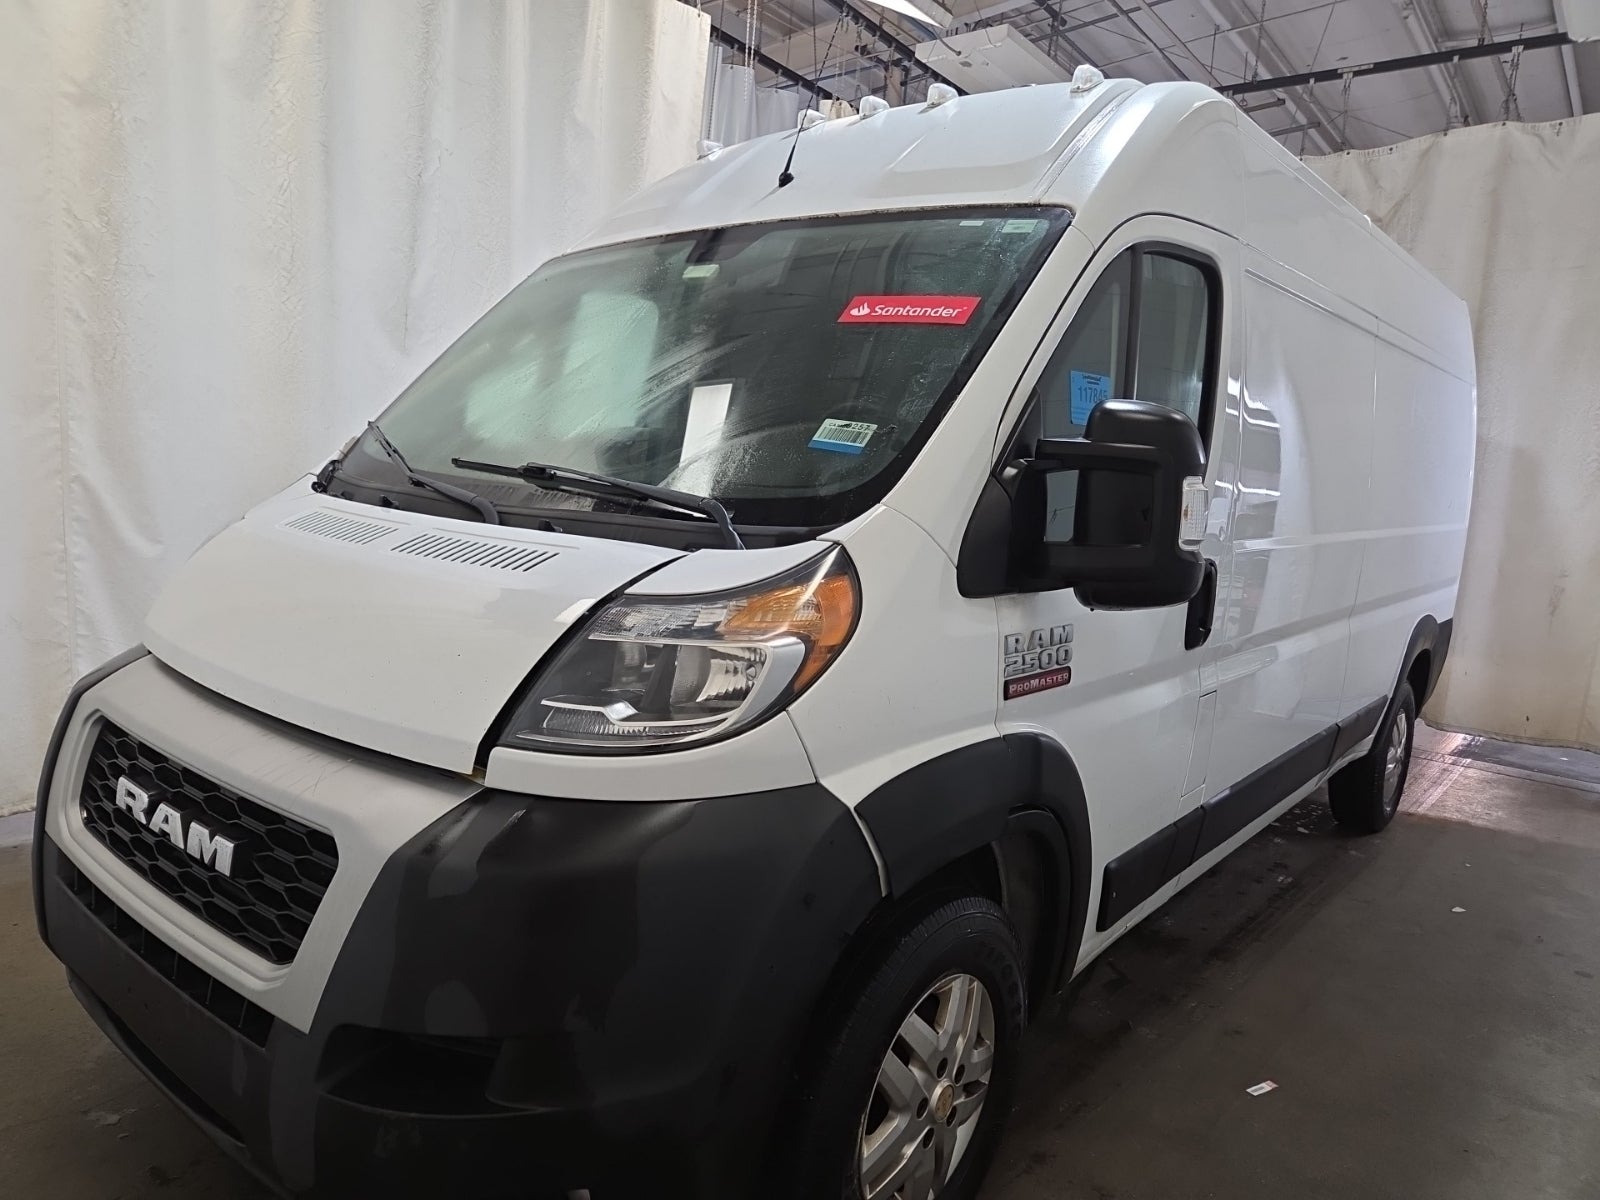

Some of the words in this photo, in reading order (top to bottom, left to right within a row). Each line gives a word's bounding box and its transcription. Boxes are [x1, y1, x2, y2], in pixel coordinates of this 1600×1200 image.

[870, 304, 962, 318] Santander
[1004, 623, 1073, 656] RAM
[1004, 644, 1073, 679] 2500
[115, 775, 236, 878] RAM
